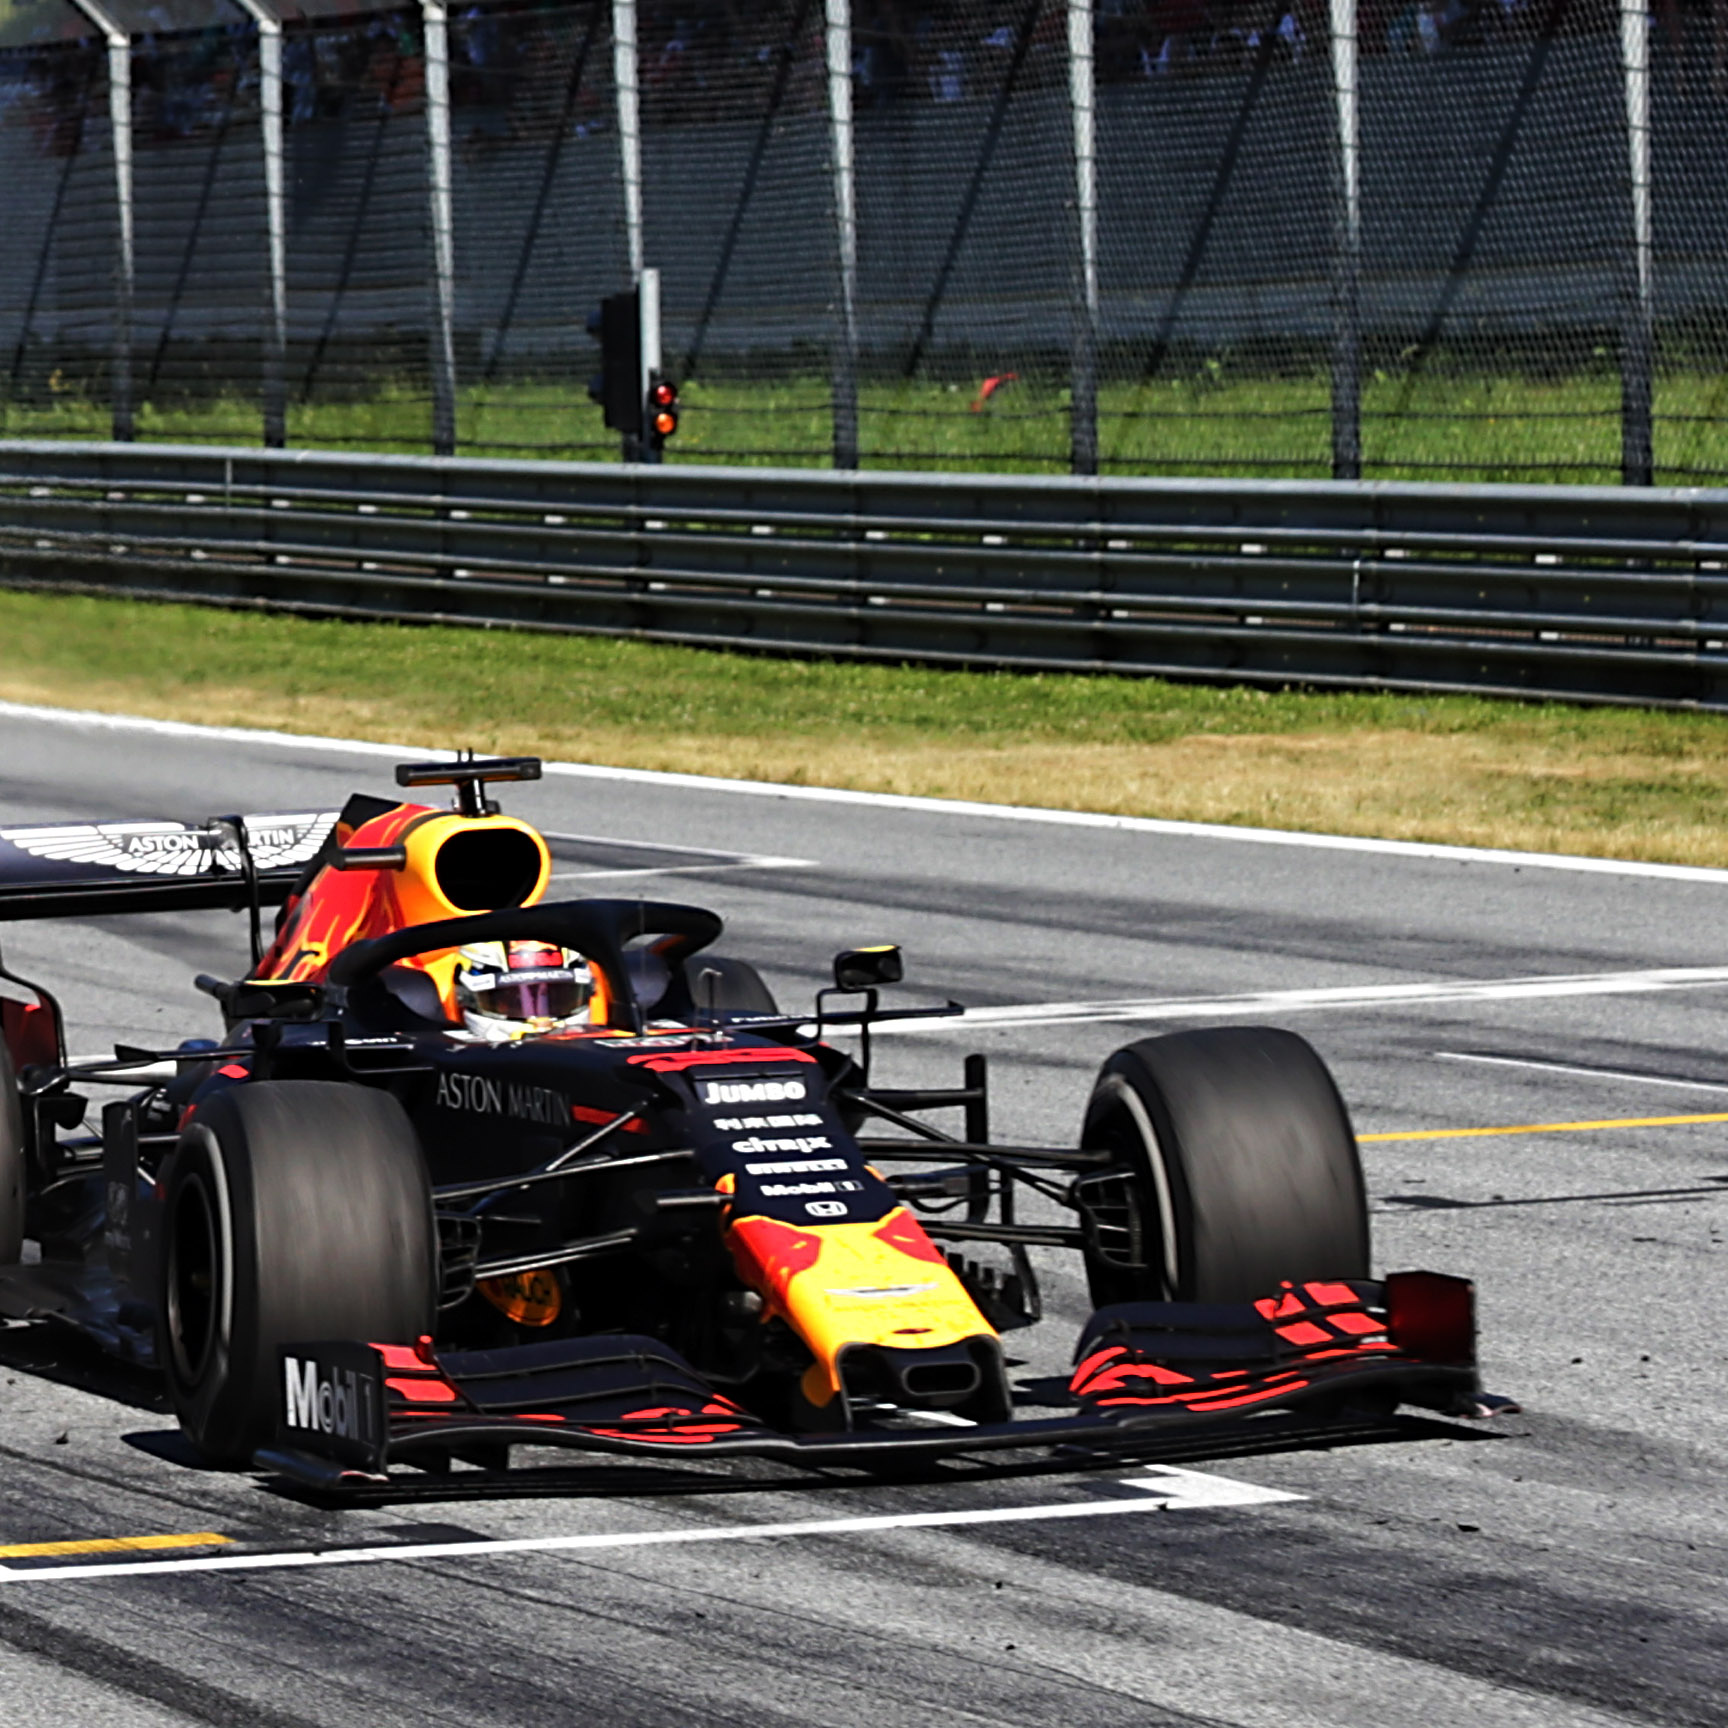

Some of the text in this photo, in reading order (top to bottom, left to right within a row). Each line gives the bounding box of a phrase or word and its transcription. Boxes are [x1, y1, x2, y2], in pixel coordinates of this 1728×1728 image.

[128, 828, 294, 853] ASTON RTIN
[436, 1072, 571, 1126] ASTON MARTIN
[705, 1081, 806, 1104] JUMBO
[284, 1356, 359, 1441] Mobil
